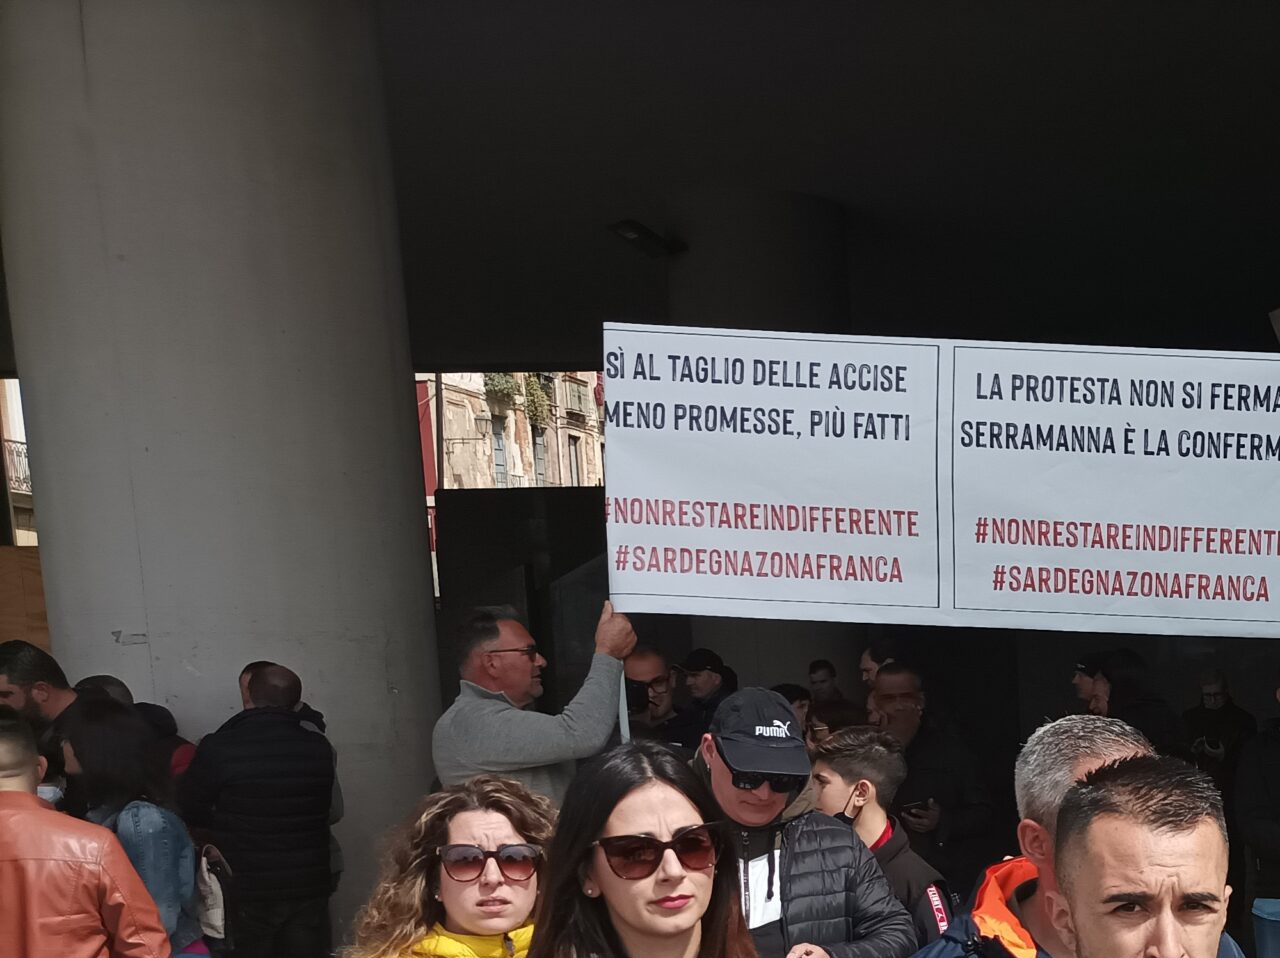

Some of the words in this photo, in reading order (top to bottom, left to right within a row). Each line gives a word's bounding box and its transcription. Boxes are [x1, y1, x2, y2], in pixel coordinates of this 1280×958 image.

[606, 347, 624, 379] SÌ
[633, 353, 660, 381] AL
[668, 355, 744, 385] TAGLIO
[753, 360, 821, 389] DELLE
[828, 363, 907, 393] ACCISE
[976, 372, 1003, 400] LA
[1011, 374, 1122, 406] PROTESTA
[1130, 379, 1175, 408] NON
[1182, 381, 1202, 409] SI
[604, 401, 665, 430] MENO
[674, 404, 801, 439] PROMESSE,
[810, 406, 844, 438] PIÙ
[853, 413, 910, 441] FATTI
[960, 421, 1116, 455] SERRAMANNA
[1123, 423, 1136, 455] È
[1143, 428, 1170, 457] LA
[615, 545, 903, 583] #SARDEGNAZONAFRANCA
[992, 565, 1270, 602] #SARDEGNAZONAFRANCA
[756, 726, 785, 738] PUMA
